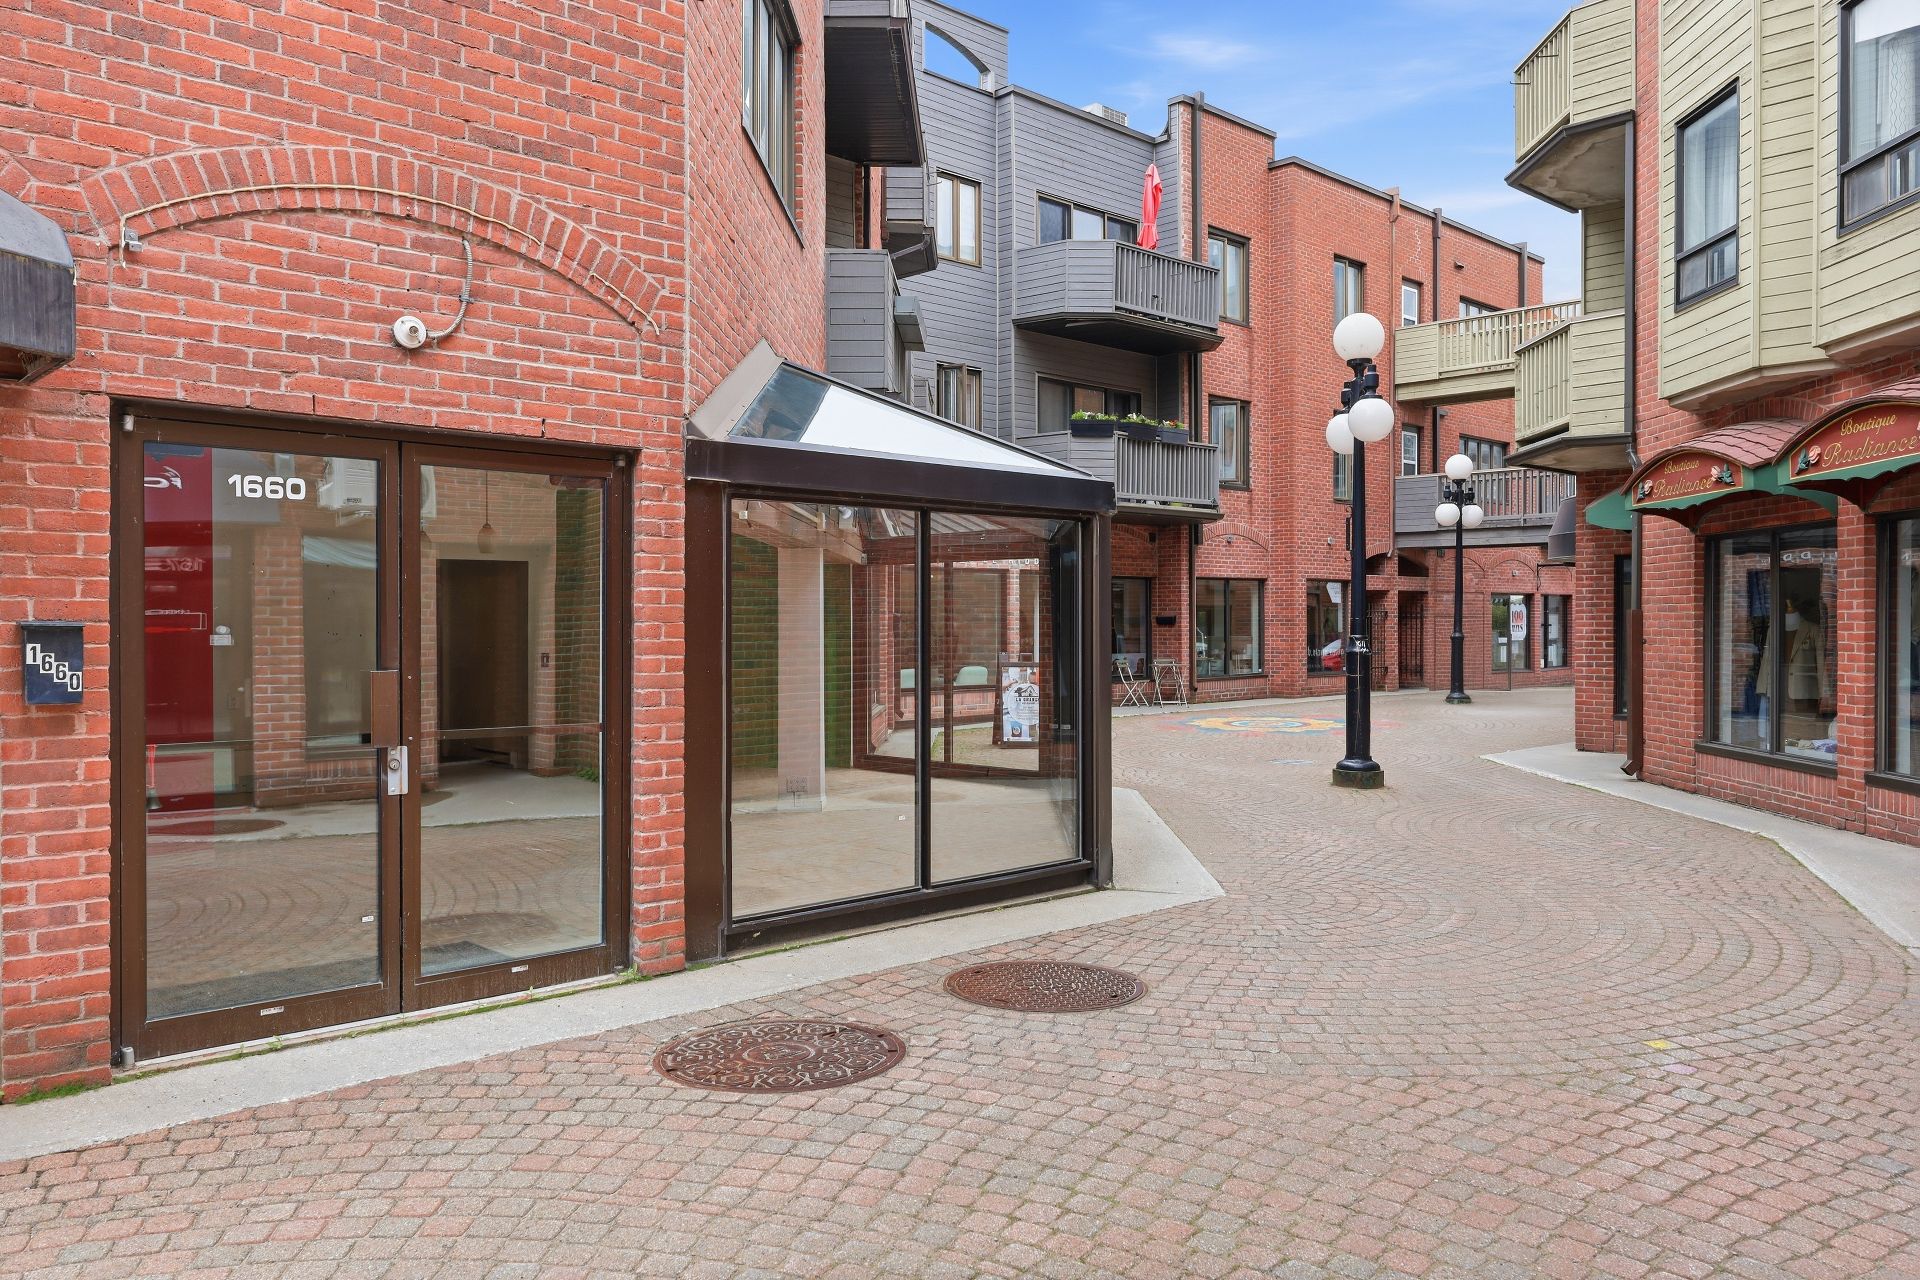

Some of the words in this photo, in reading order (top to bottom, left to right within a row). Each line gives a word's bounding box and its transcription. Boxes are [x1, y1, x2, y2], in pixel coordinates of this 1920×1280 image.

[1840, 414, 1897, 435] Boutique
[1822, 436, 1919, 467] Radiance
[227, 474, 306, 500] 1660
[1653, 477, 1713, 498] Radiance
[28, 645, 81, 690] 1660
